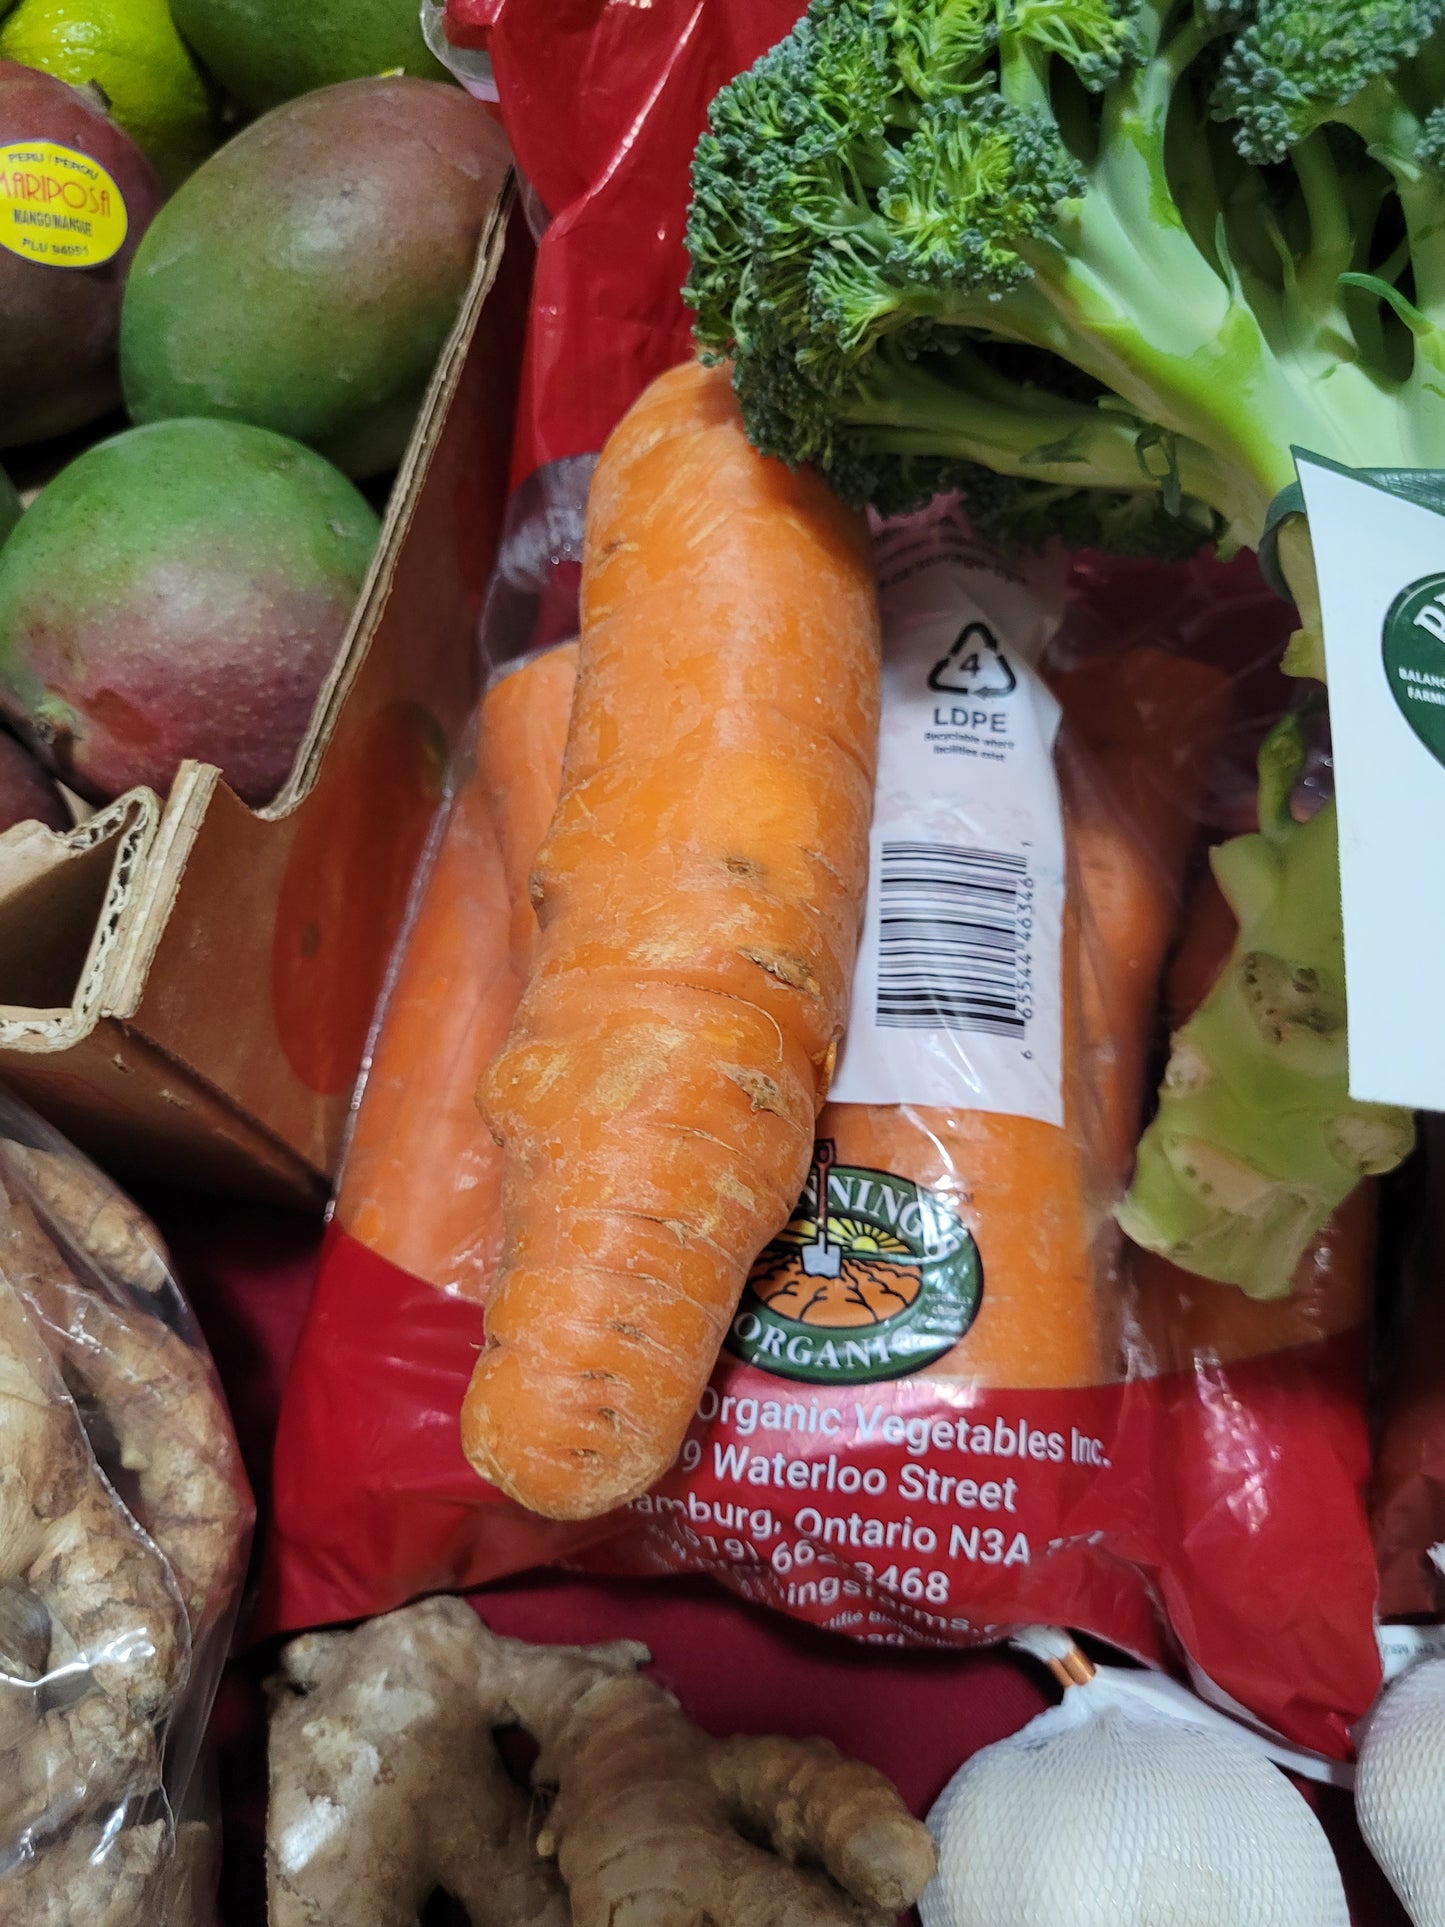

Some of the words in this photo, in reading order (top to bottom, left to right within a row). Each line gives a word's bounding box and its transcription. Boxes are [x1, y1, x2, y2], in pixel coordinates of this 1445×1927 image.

[960, 653, 981, 678] 4
[934, 706, 1007, 733] LDPE
[855, 1403, 1066, 1463] Vegetables
[1071, 1426, 1113, 1468] Inc.
[714, 1442, 888, 1496] Waterloo
[899, 1463, 1018, 1514] Street
[627, 1491, 783, 1540] amburg,
[794, 1506, 937, 1554] Ontario
[949, 1523, 1031, 1567] N3A
